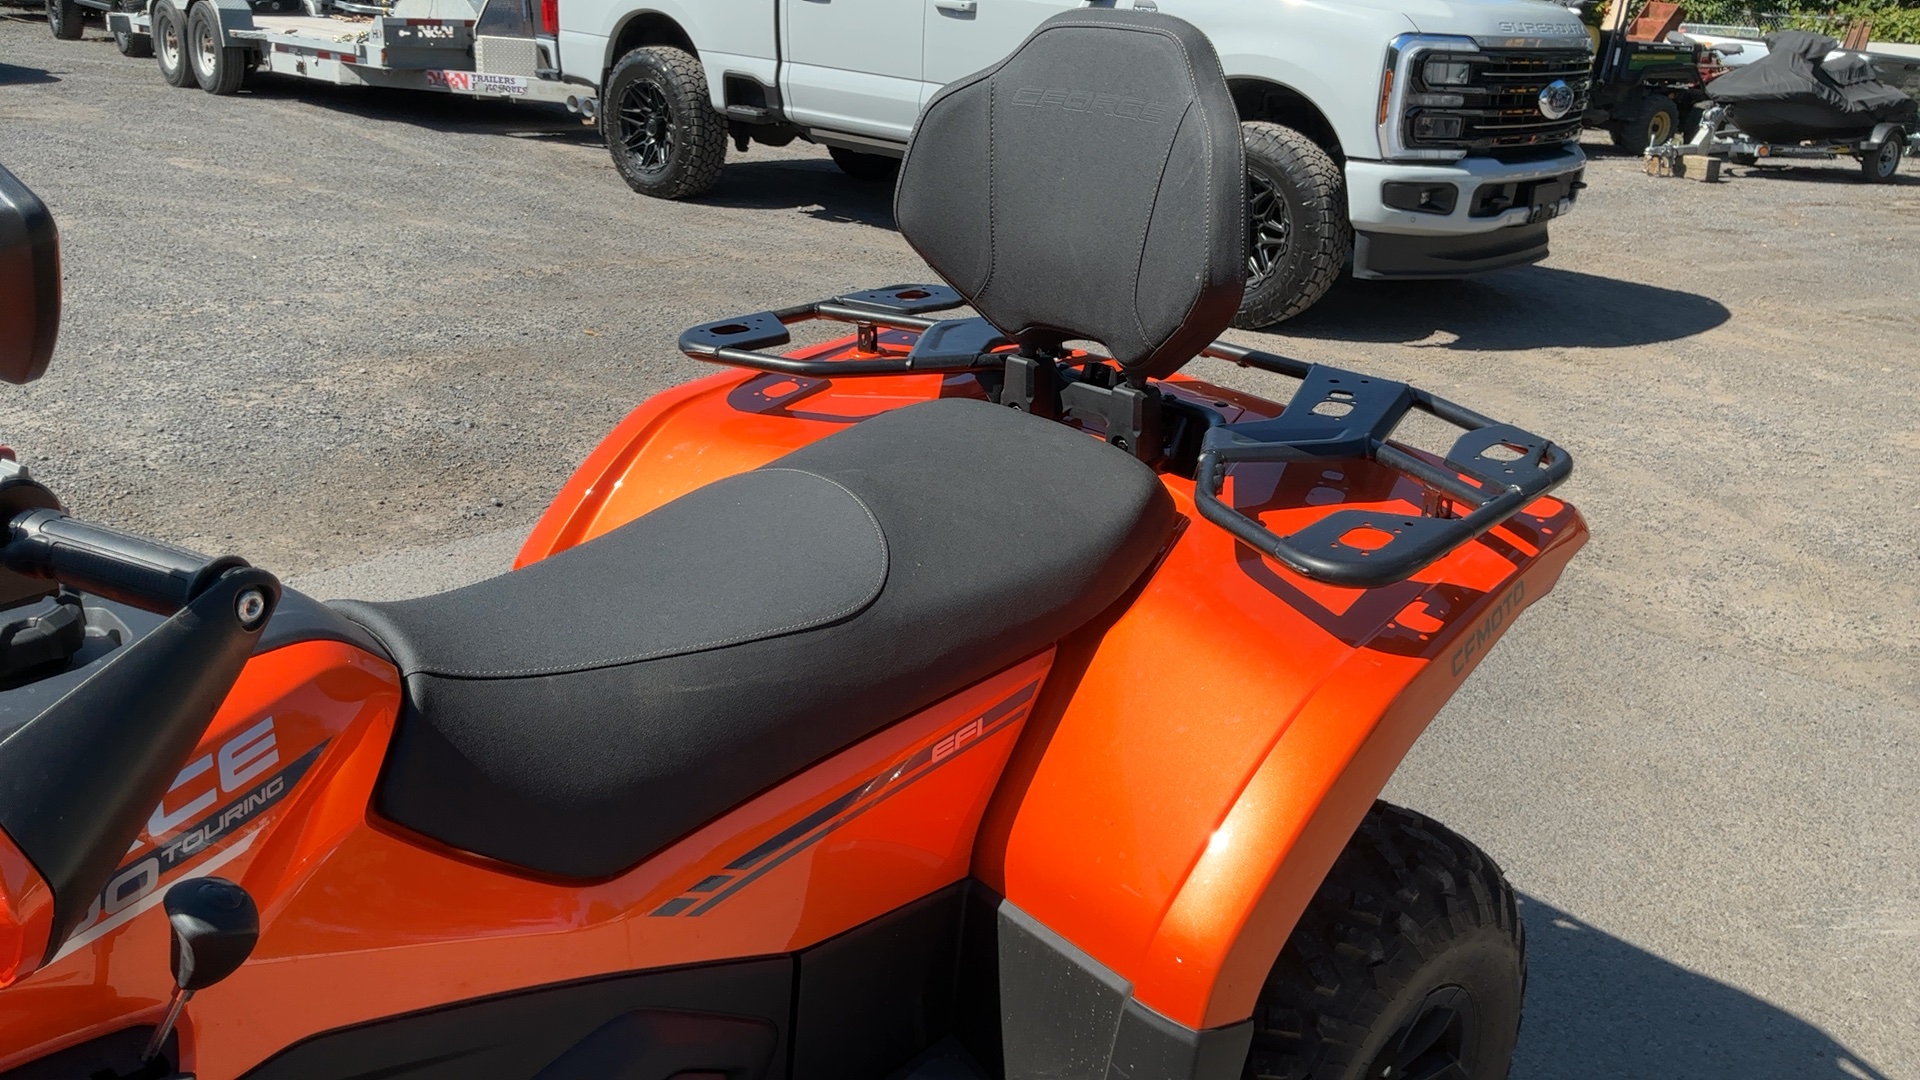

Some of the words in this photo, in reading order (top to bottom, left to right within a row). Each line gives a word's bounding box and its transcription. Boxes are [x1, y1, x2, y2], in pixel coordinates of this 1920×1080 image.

[471, 74, 516, 85] TRAILERS
[1011, 87, 1168, 124] CFORCE
[1451, 579, 1525, 677] CFMOTO
[931, 717, 984, 763] EFI
[160, 775, 285, 863] TOURING
